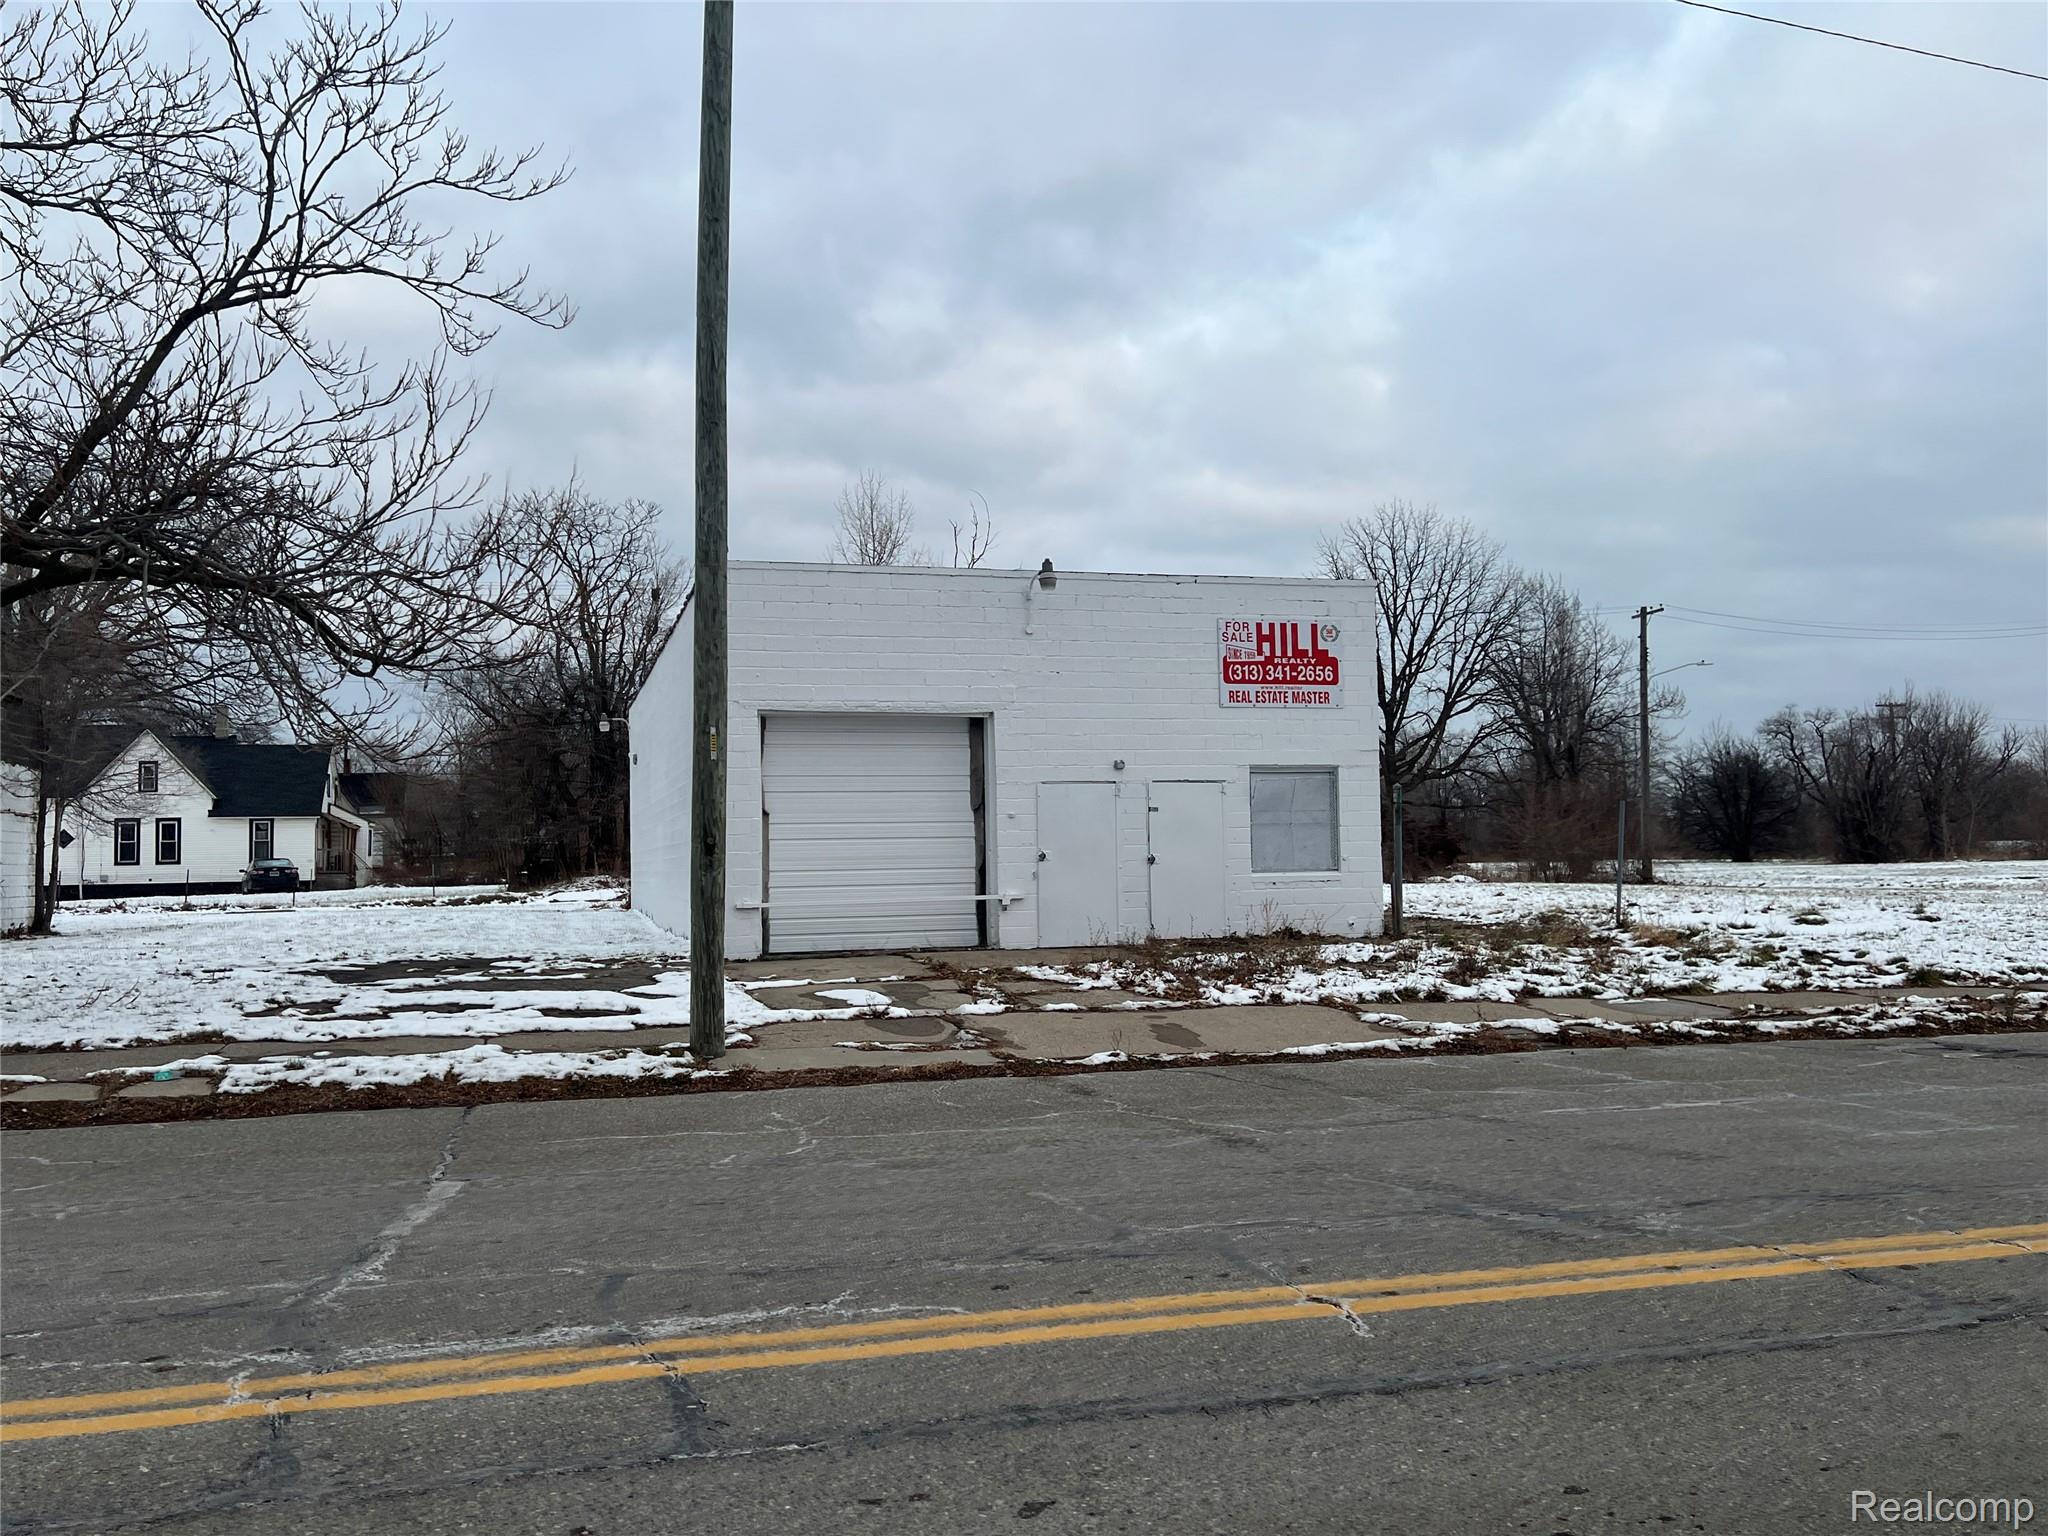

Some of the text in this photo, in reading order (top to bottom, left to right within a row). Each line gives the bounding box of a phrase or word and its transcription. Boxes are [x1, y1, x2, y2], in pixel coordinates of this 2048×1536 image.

[1225, 621, 1250, 632] FOR
[1222, 632, 1254, 643] SALE
[1256, 622, 1329, 658] HILL
[1228, 664, 1333, 681] (313) 341-2656
[1228, 690, 1330, 705] REAL ESTATE MASTER
